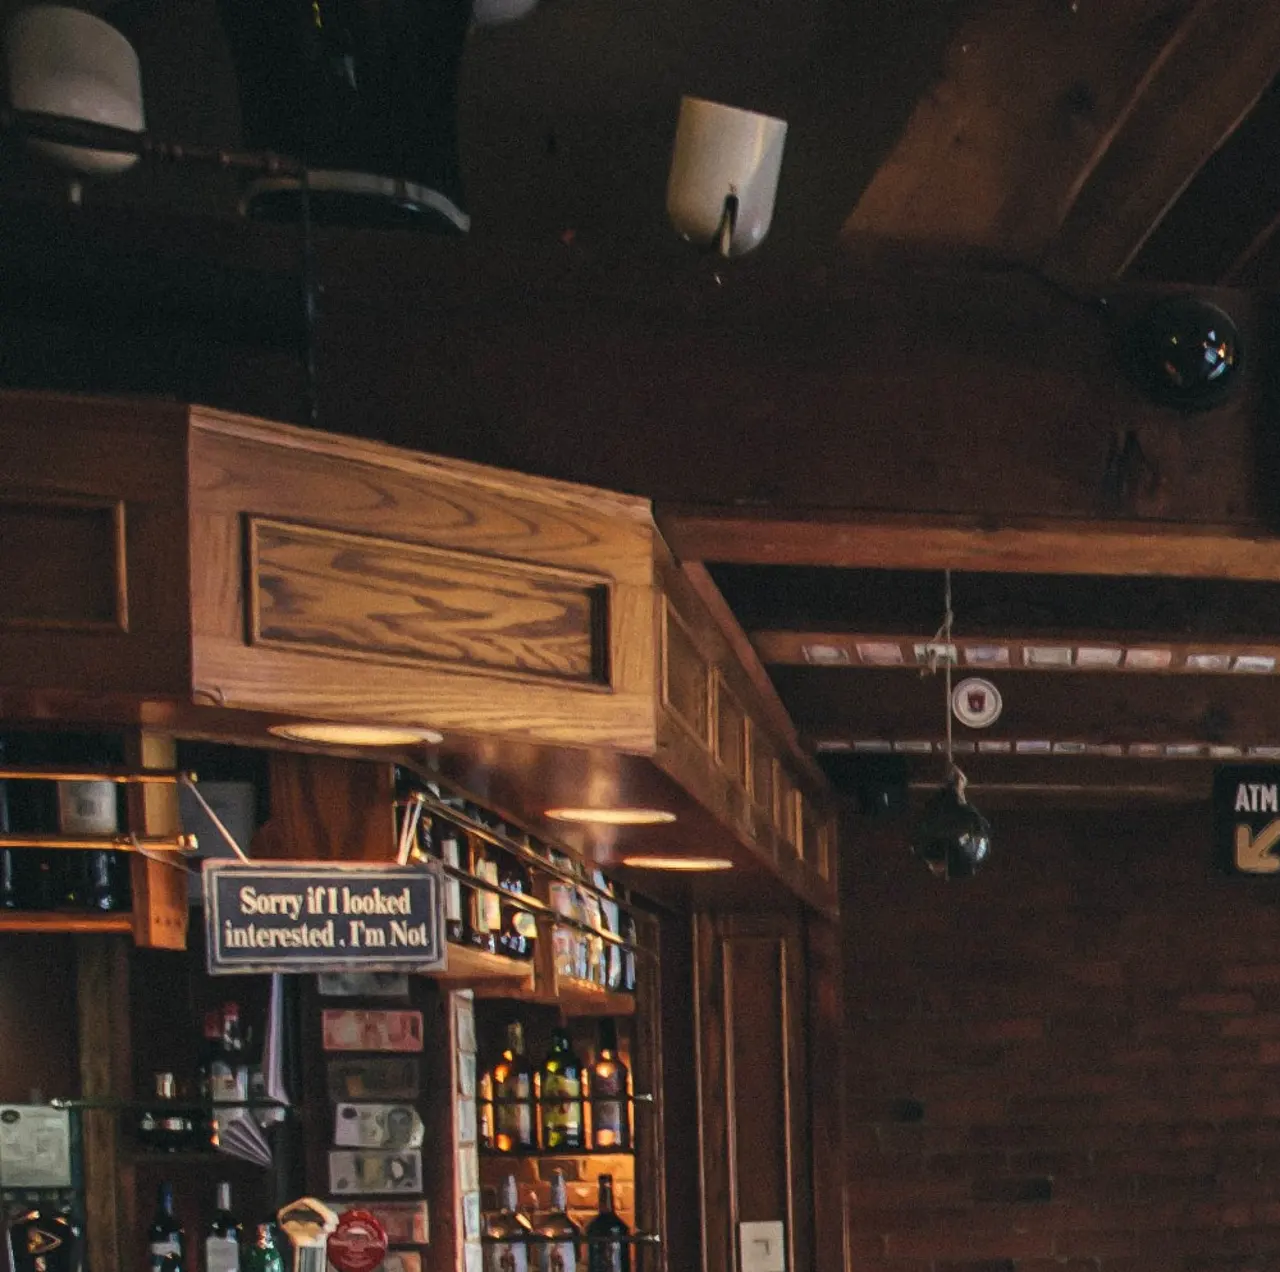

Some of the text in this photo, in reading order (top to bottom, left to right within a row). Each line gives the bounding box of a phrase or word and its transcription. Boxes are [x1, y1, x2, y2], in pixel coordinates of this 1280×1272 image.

[1234, 782, 1279, 813] ATM
[239, 885, 411, 921] Sorry if I looked
[348, 920, 385, 948] I'm
[389, 920, 428, 947] Not
